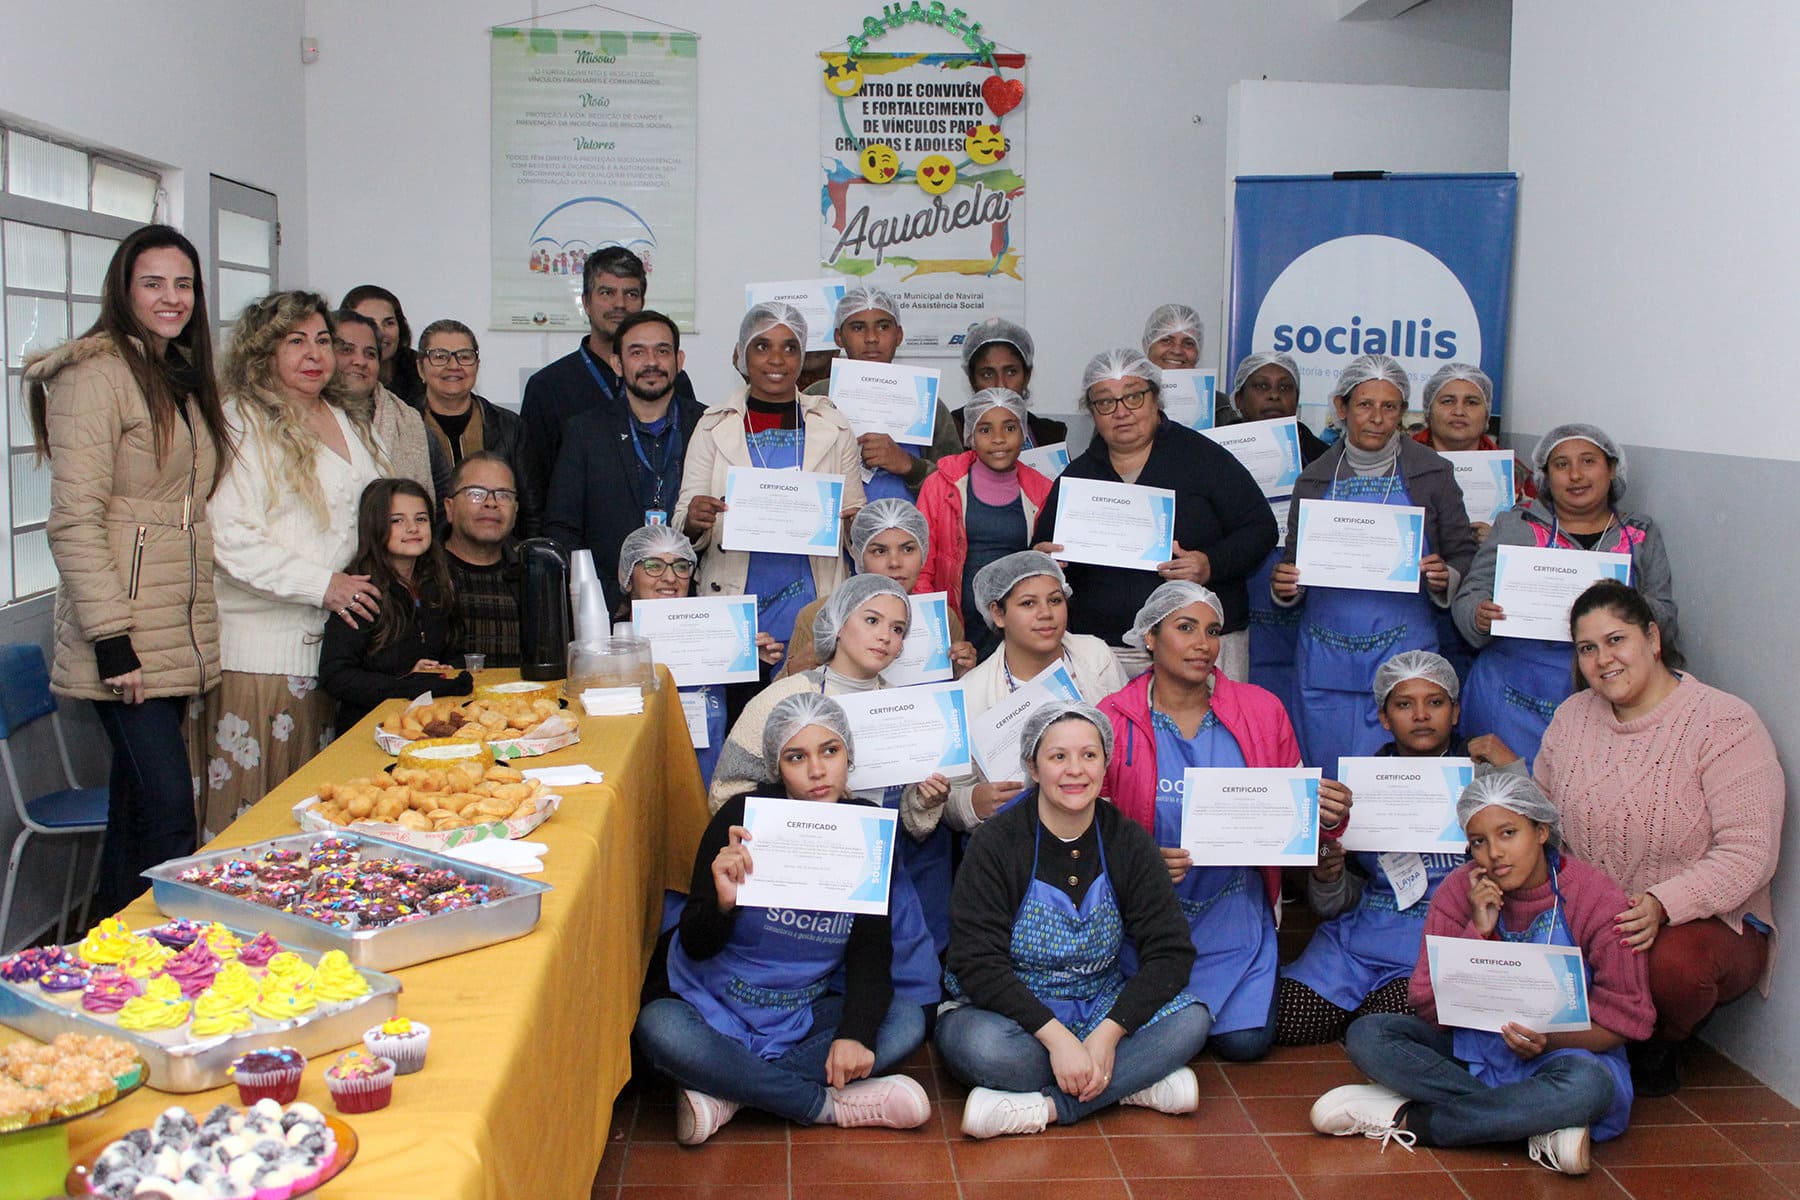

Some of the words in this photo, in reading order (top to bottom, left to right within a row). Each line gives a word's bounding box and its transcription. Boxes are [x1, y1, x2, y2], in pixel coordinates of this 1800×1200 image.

[853, 82, 893, 97] NTRO
[897, 83, 913, 97] DE
[916, 81, 983, 98] CONVIVÊN
[862, 101, 870, 115] E
[873, 101, 984, 116] FORTALECIMENTO
[863, 119, 879, 133] DE
[882, 117, 946, 134] VÍNCULOS
[573, 135, 616, 151] Valores
[905, 137, 912, 151] E
[828, 183, 1010, 266] Aquarela
[904, 291, 942, 301] Municipal
[944, 291, 954, 300] de
[912, 301, 958, 310] Assistência
[960, 301, 985, 309] Social
[1273, 315, 1458, 360] sociallis
[759, 483, 799, 492] CERTIFICADO
[1333, 516, 1376, 525] CERTIFICADO
[1533, 565, 1578, 575] CERTIFICADO
[667, 612, 710, 621] CERTIFICADO
[869, 703, 915, 715] CERTIFICADO
[995, 700, 1031, 729] CERTIFICADO
[1222, 786, 1268, 794] CERTIFICADO
[786, 820, 838, 832] CERTIFICADO
[1470, 957, 1522, 967] CERTIFICADO
